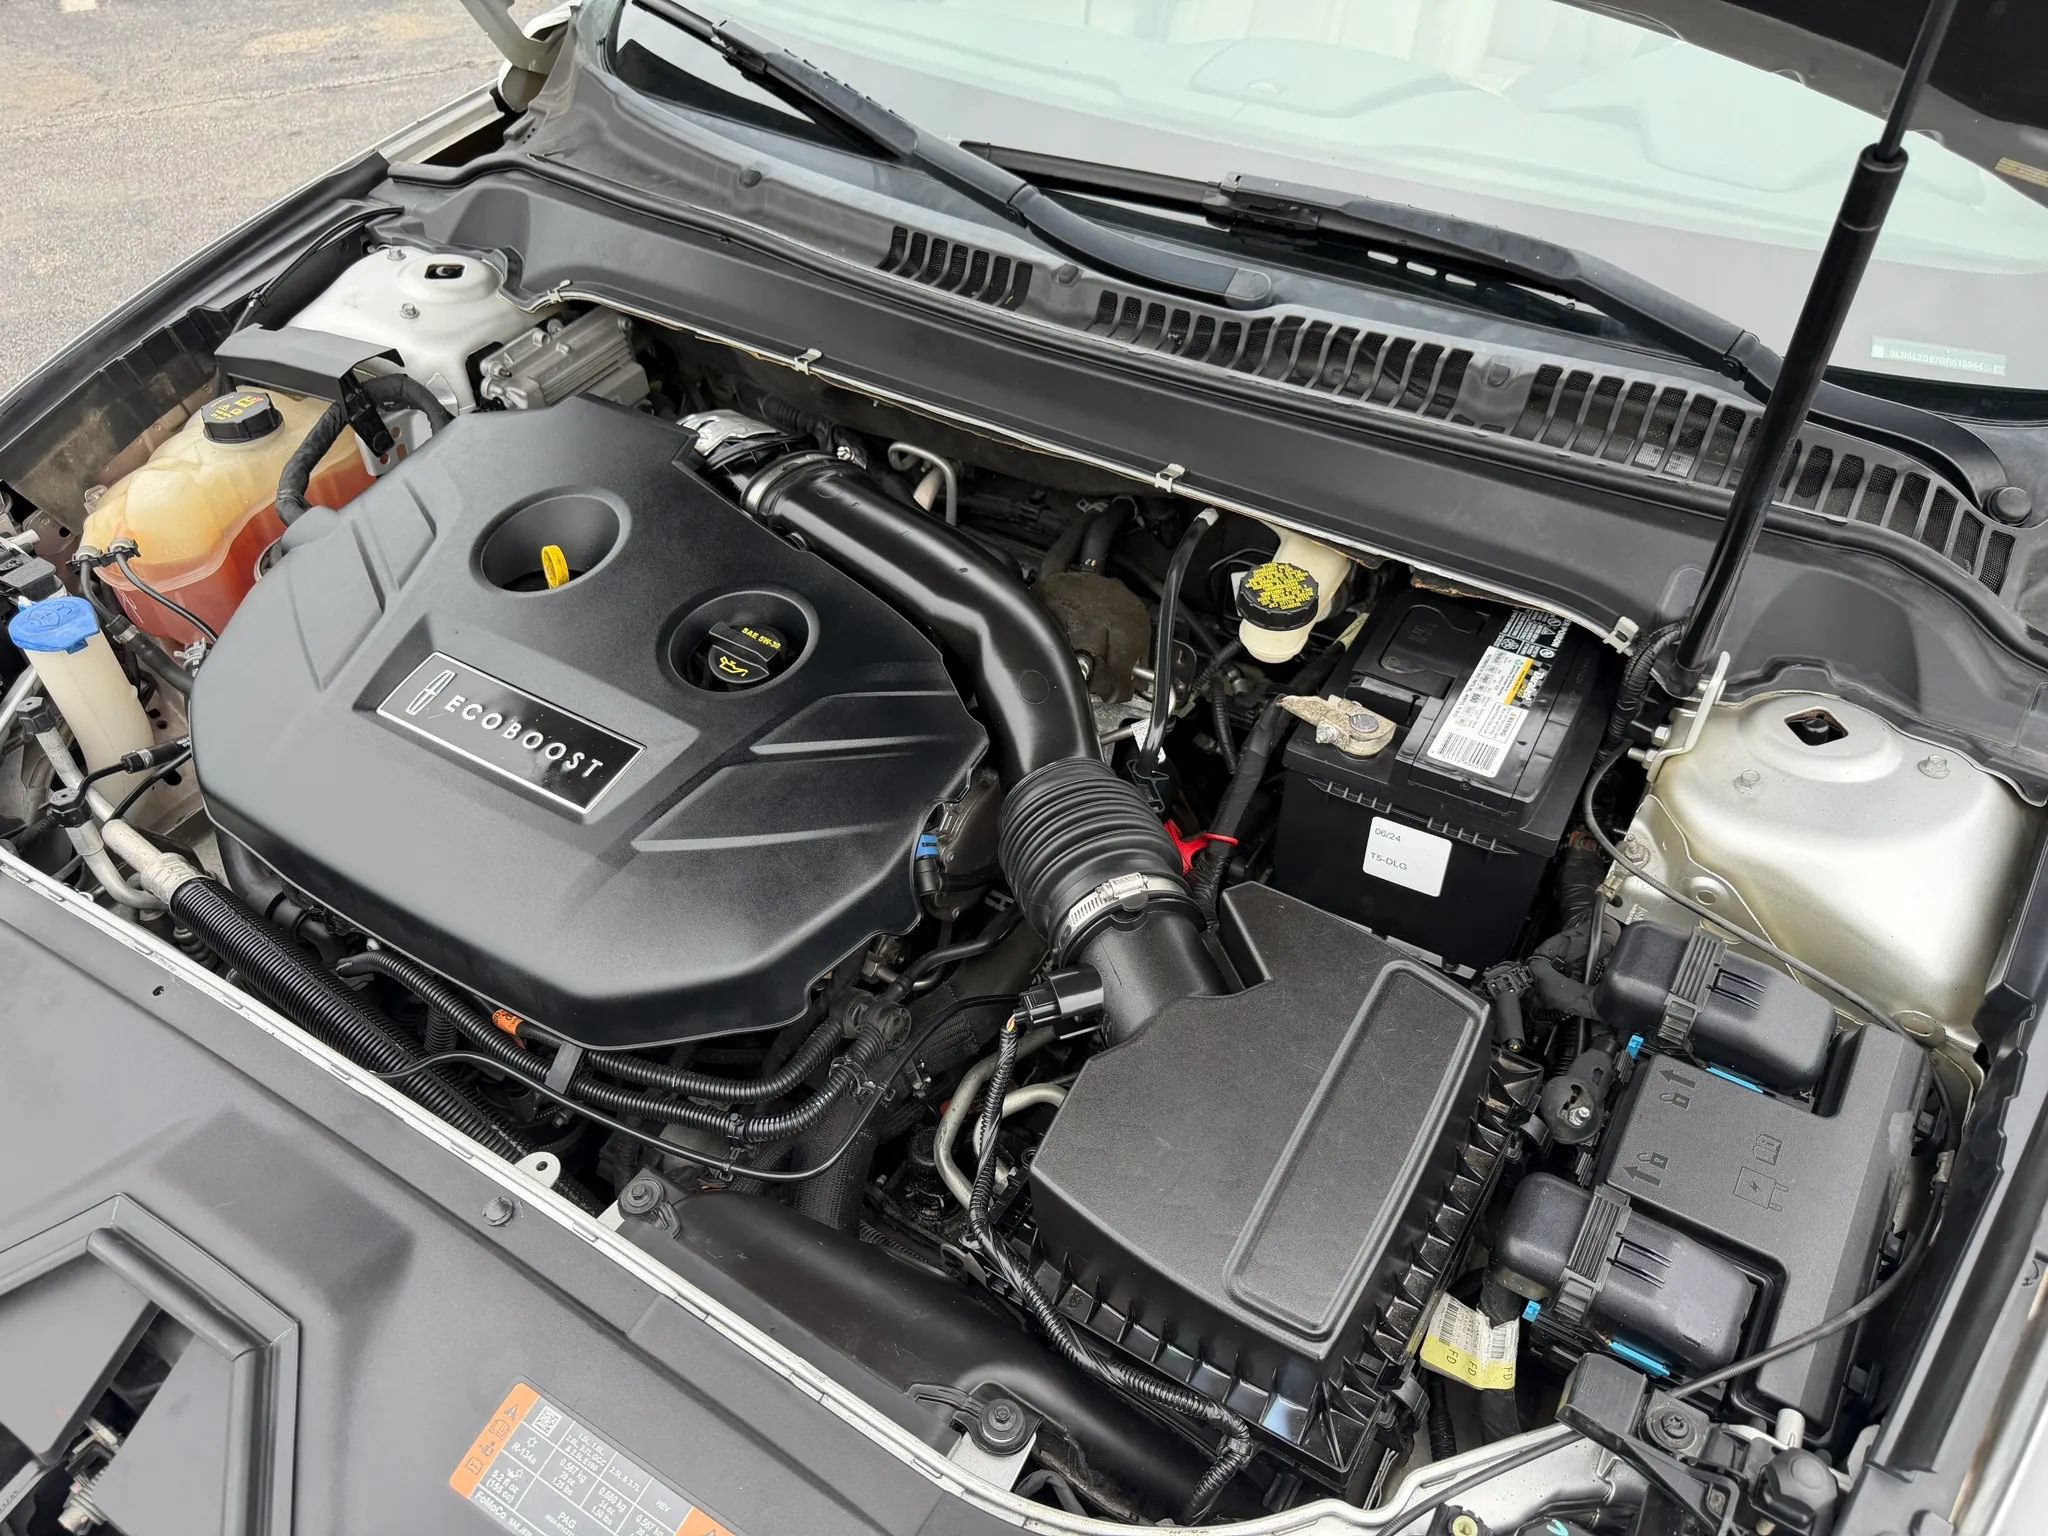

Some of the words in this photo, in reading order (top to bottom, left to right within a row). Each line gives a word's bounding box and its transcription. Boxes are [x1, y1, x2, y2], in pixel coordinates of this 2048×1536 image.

[742, 627, 758, 640] SAE
[758, 635, 781, 650] 5W-30
[1522, 671, 1545, 700] Duralast
[444, 694, 603, 778] ECOBOOST
[1374, 827, 1401, 842] 06/24
[1370, 851, 1408, 871] T5-DLG
[1446, 1349, 1459, 1364] FD
[1468, 1361, 1478, 1376] FD
[1503, 1366, 1513, 1380] FD
[511, 1442, 537, 1465] R-134a
[560, 1458, 579, 1474] 0.567
[576, 1470, 588, 1483] kg
[492, 1469, 504, 1481] 5.2
[509, 1484, 520, 1494] oz
[474, 1490, 507, 1520] FoMoCo
[616, 1499, 628, 1513] kg
[655, 1499, 671, 1512] HEV
[558, 1512, 577, 1529] PAG
